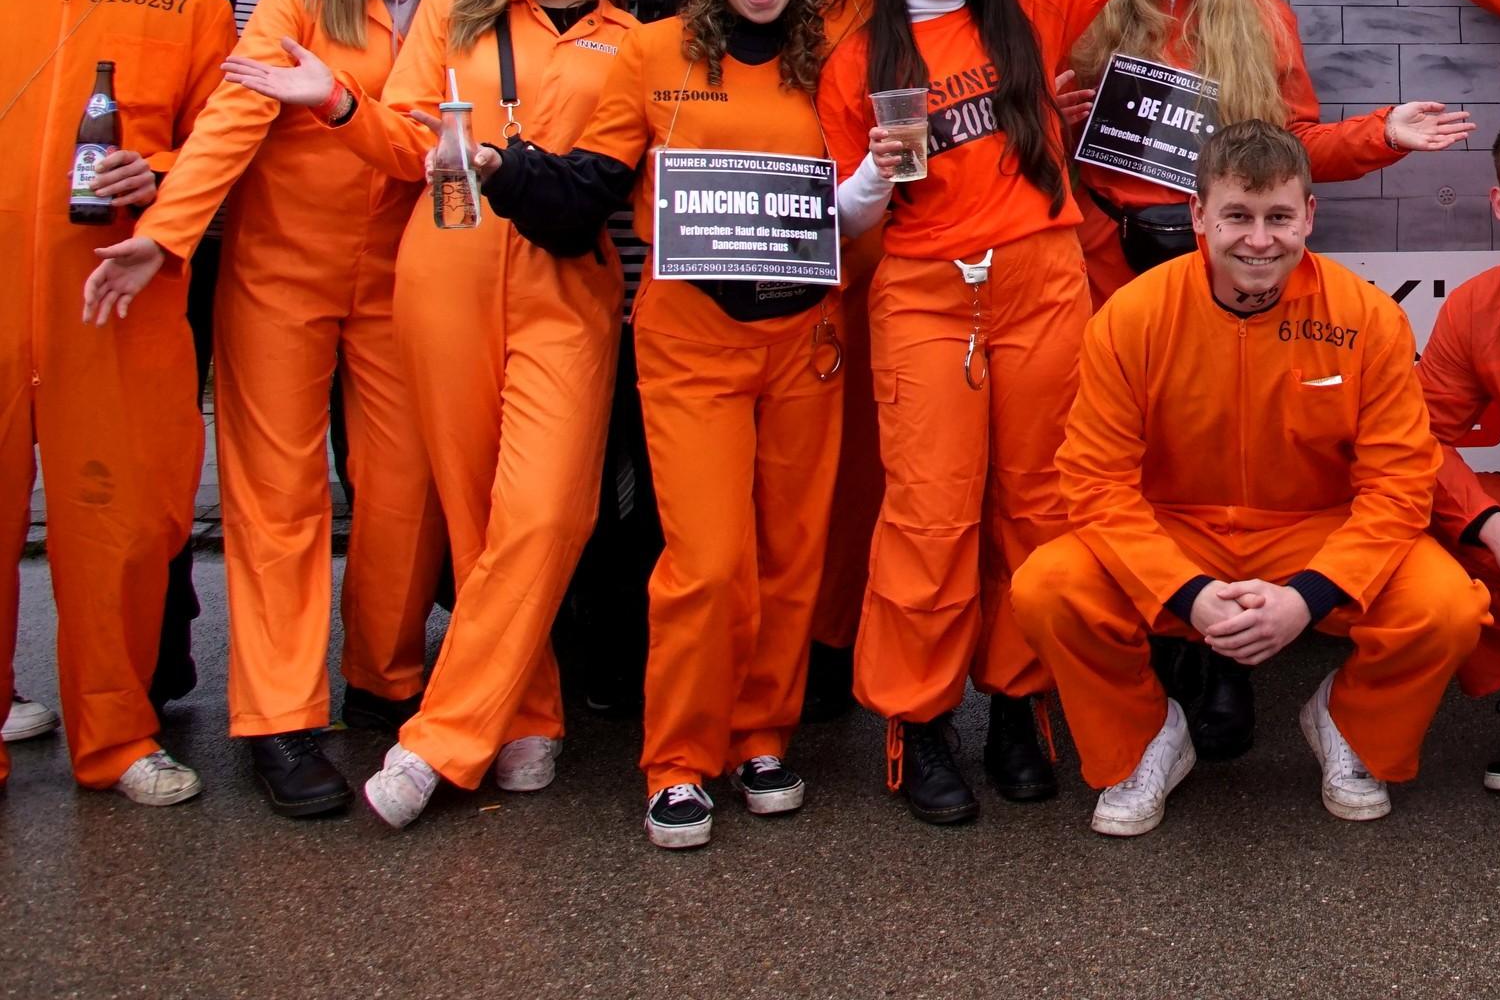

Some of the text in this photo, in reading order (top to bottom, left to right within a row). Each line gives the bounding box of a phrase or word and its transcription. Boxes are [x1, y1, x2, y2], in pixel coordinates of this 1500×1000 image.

[1114, 60, 1148, 75] MUHRER
[653, 90, 729, 102] 38750008
[1137, 97, 1205, 134] BE LATE
[1100, 124, 1141, 143] Verbrechen:
[1152, 138, 1178, 154] immer
[1177, 146, 1187, 156] zu
[664, 157, 831, 176] MUHRER JUSTIZVOLLZUGSANSTALT
[1081, 148, 1198, 188] 123456789012345678901234
[674, 190, 822, 220] DANCING QUEEN
[680, 225, 818, 241] Verbrechen: Haut die krassesten
[712, 239, 789, 252] Dancemoves raus
[661, 263, 836, 277] 123456789012345678901234567890
[1279, 319, 1359, 350] 6103297
